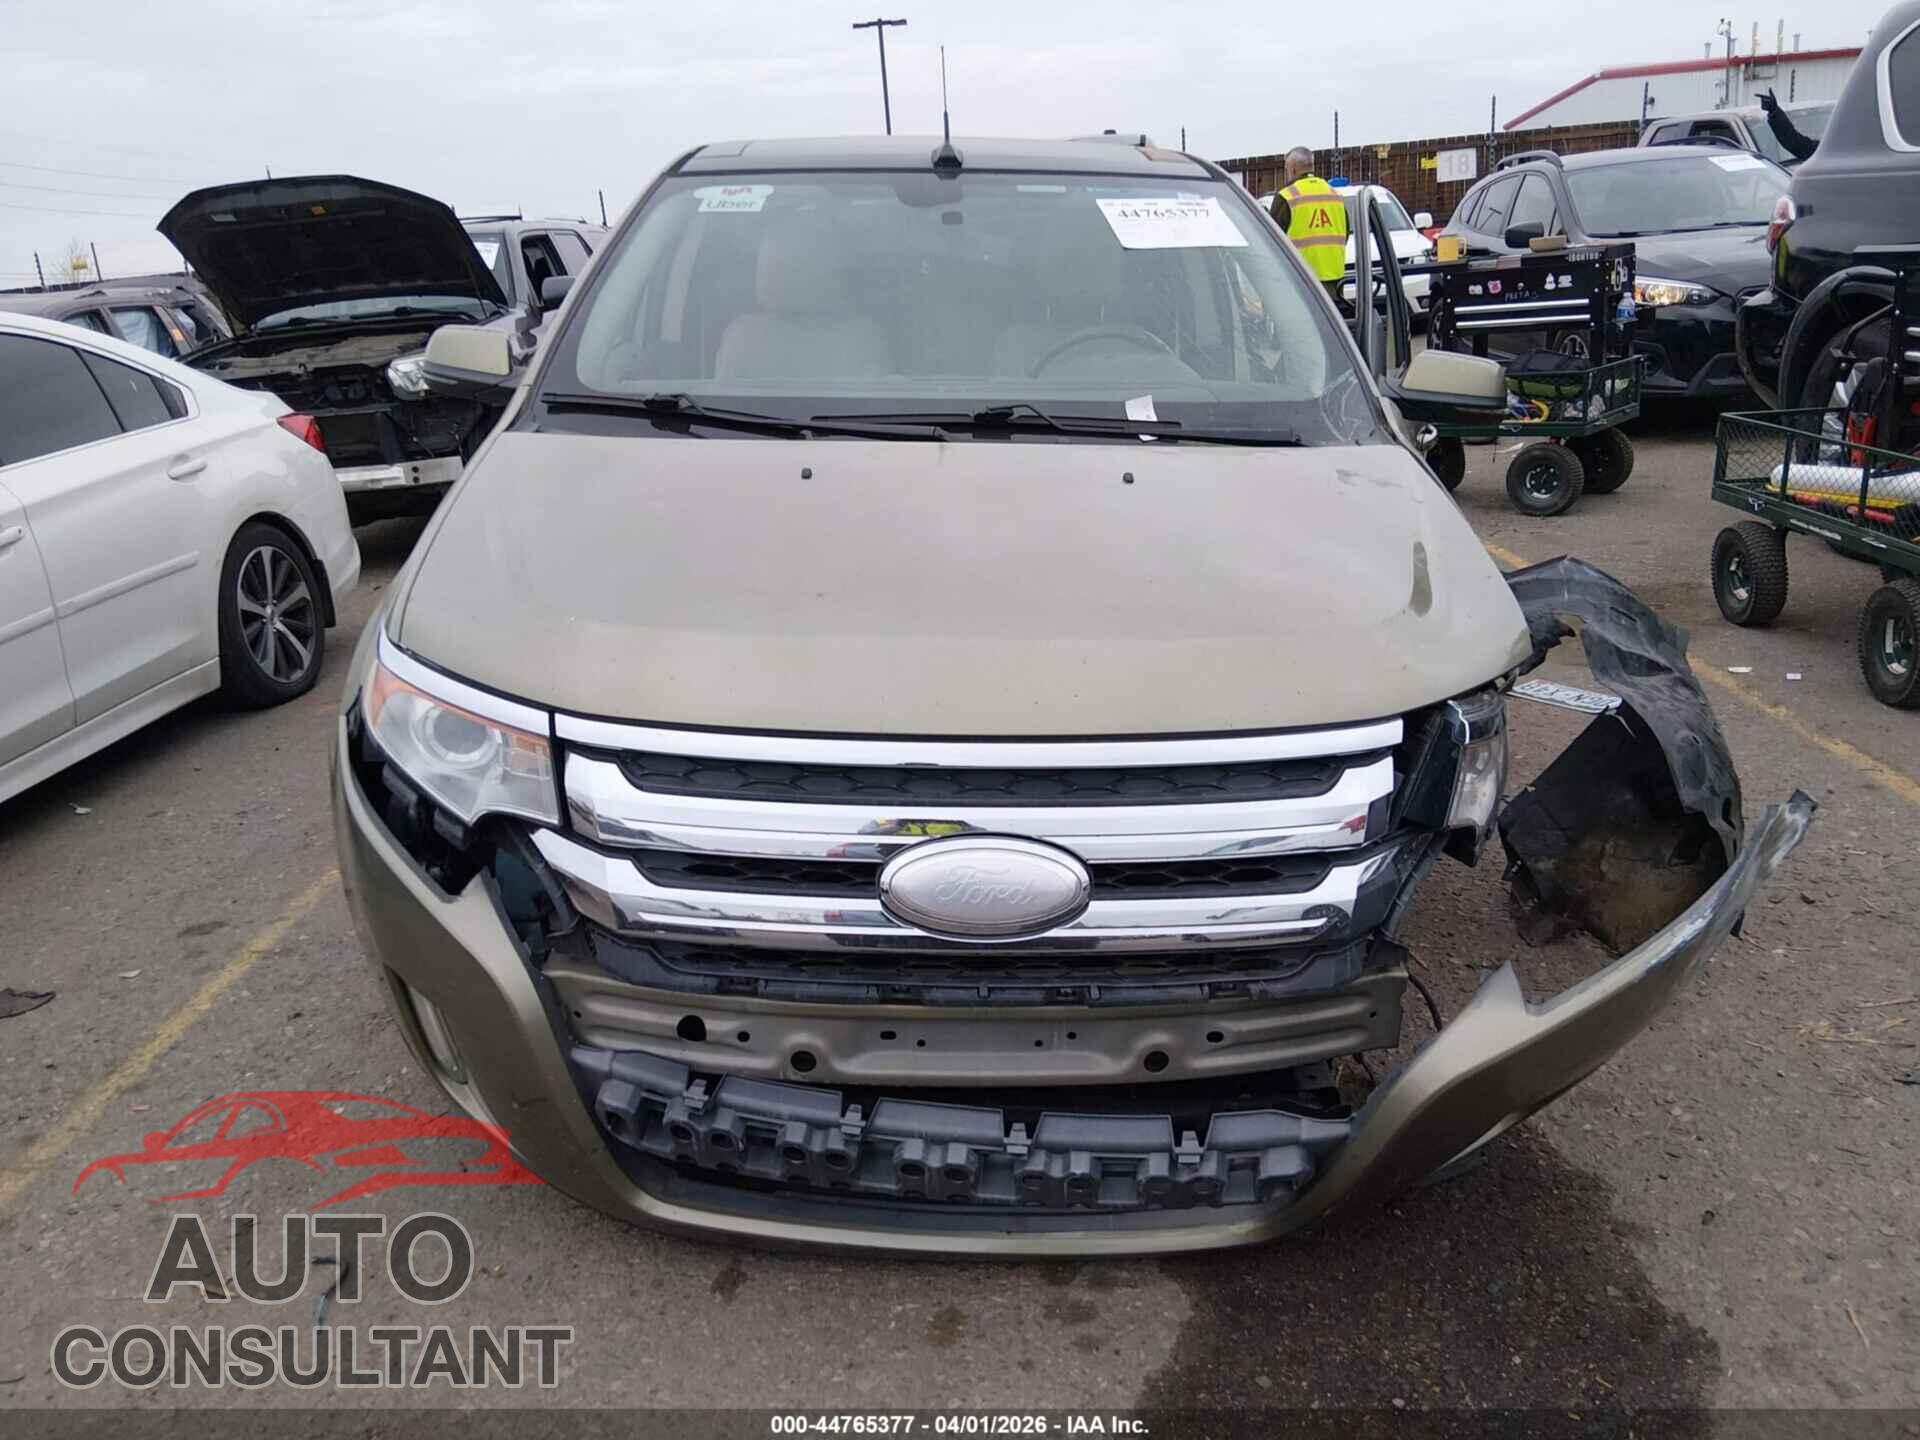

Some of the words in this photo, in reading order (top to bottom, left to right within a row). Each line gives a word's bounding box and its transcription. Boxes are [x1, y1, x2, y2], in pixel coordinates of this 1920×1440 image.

[1445, 153, 1470, 177] 18
[1117, 207, 1211, 219] 44765377
[936, 865, 1037, 906] Ford
